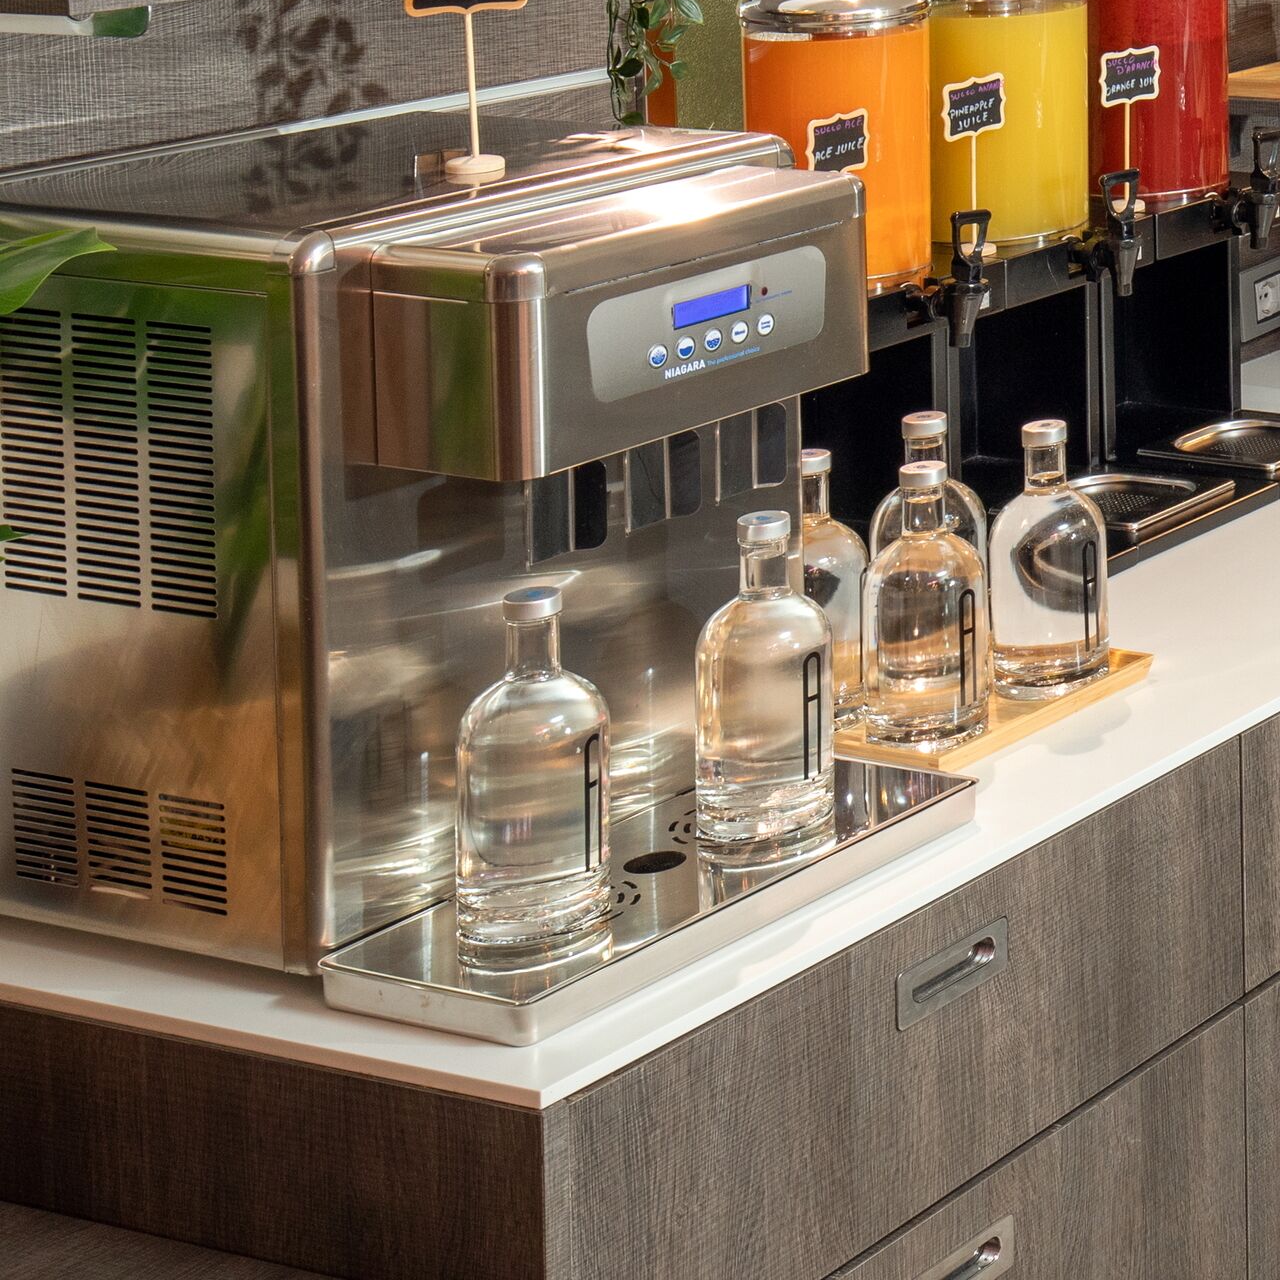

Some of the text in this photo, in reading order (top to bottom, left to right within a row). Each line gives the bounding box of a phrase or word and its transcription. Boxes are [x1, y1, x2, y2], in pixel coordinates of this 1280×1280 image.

[1107, 56, 1136, 67] SUCCO
[951, 89, 975, 100] SUCCO
[1105, 79, 1136, 96] ORANGE
[950, 97, 995, 120] PINEAPPLE
[815, 124, 842, 136] SUCCO
[815, 136, 864, 163] ACE JUICE
[664, 359, 706, 380] NIAGARA
